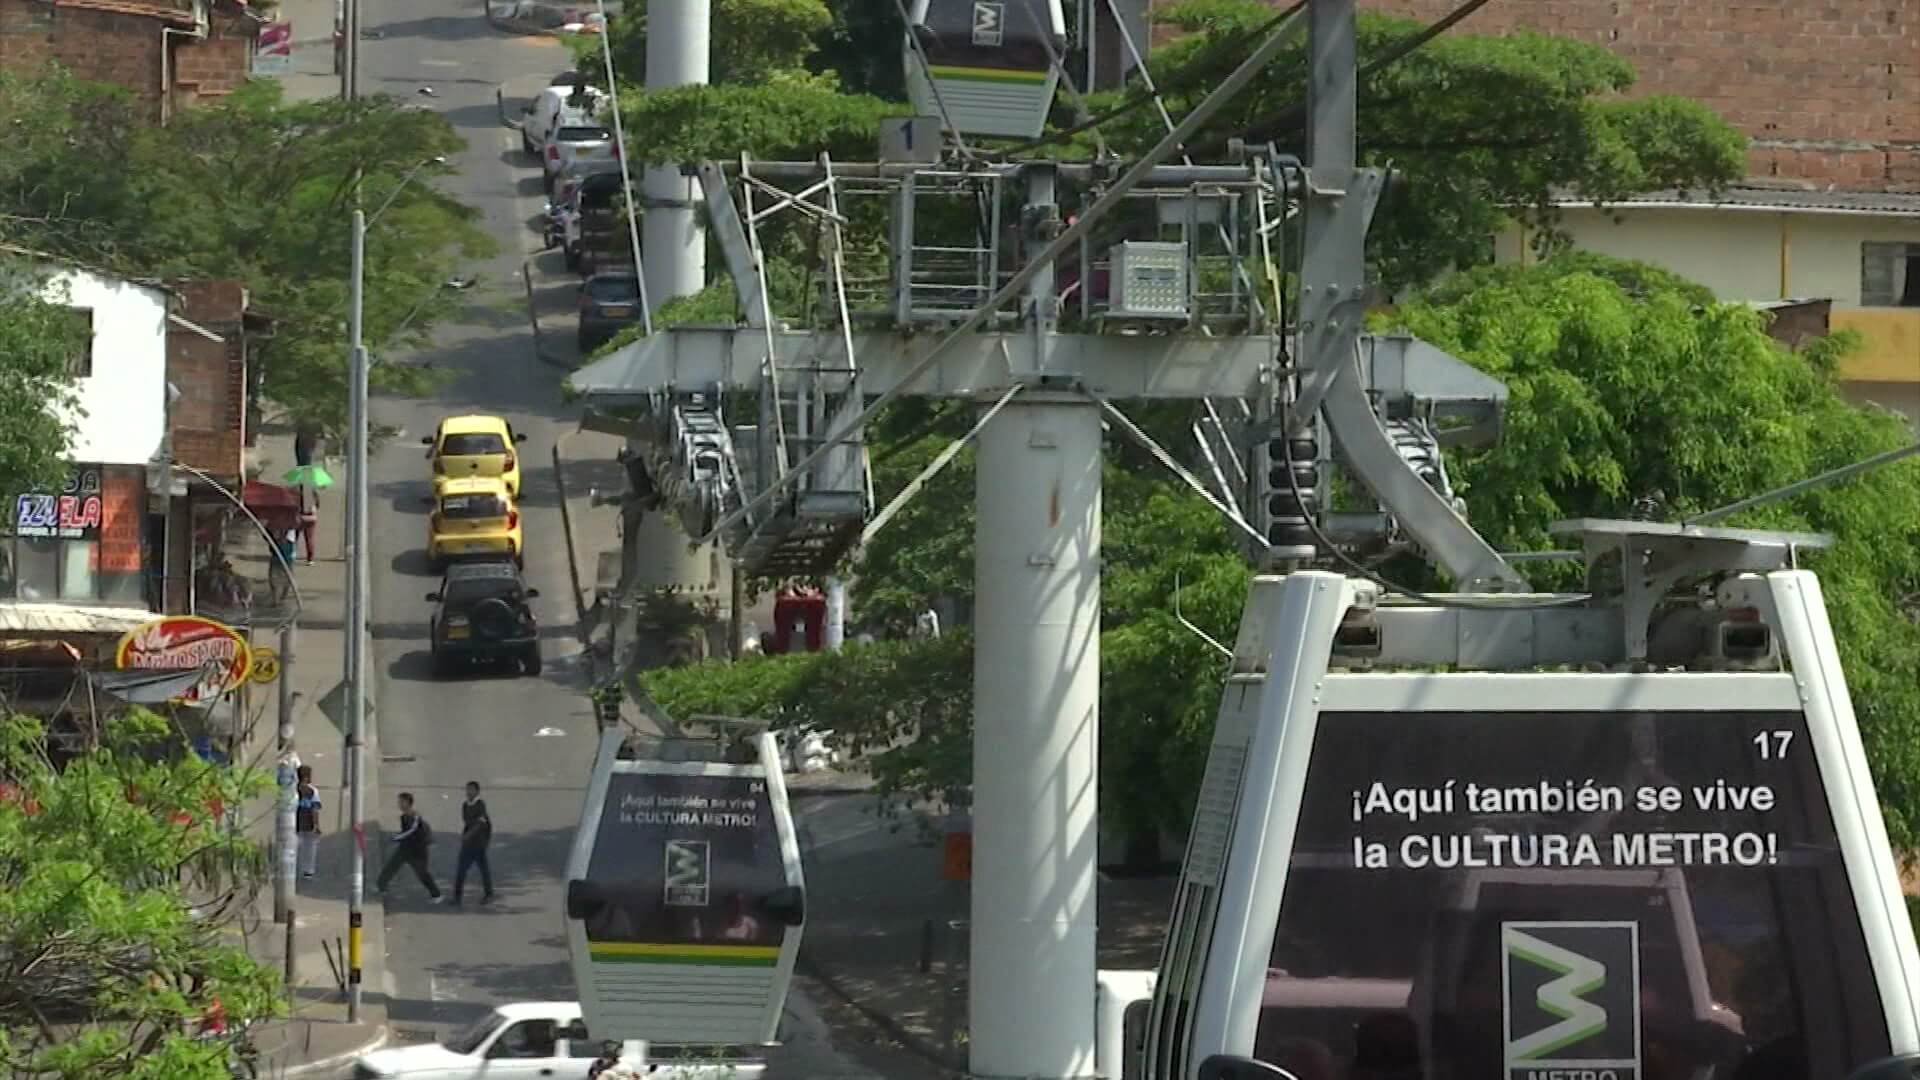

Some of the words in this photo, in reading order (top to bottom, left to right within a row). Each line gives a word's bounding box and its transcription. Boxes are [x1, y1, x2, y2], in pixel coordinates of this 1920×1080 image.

[899, 120, 913, 151] 1
[254, 660, 275, 673] 24
[1752, 730, 1794, 760] 17
[1352, 779, 1457, 821] ¡Aquí
[1466, 779, 1623, 813] también
[1636, 784, 1682, 812] se
[1692, 779, 1776, 811] vive
[635, 812, 699, 825] CULTURA
[1354, 835, 1388, 868] la
[1399, 833, 1601, 868] CULTURA
[1612, 832, 1778, 866] METRO!
